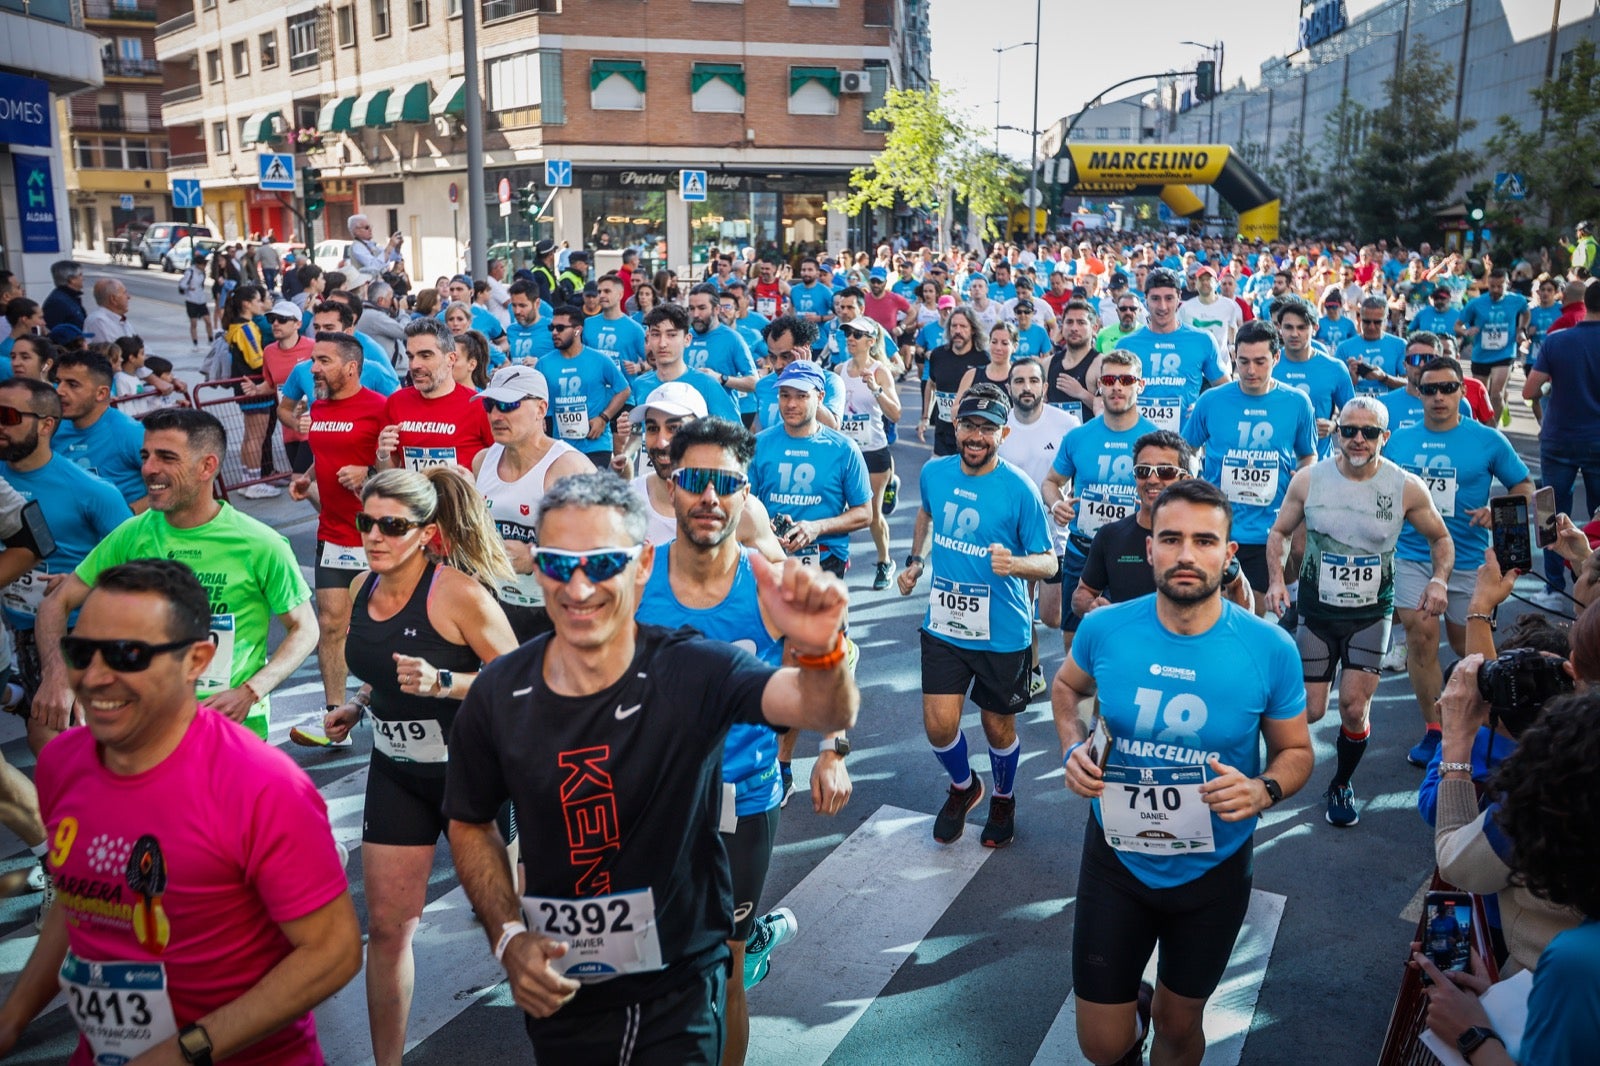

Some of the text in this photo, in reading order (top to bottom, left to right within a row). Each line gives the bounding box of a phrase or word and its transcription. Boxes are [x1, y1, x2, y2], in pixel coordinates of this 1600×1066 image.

[1088, 151, 1209, 170] MARCELINO
[1150, 353, 1181, 376] 18
[558, 375, 581, 396] 18
[558, 413, 582, 423] 1500
[1141, 407, 1174, 419] 2043
[310, 421, 354, 433] MARCELINO
[400, 420, 456, 435] MARCELINO
[841, 421, 864, 431] 2421
[1237, 421, 1274, 449] 18
[1227, 449, 1280, 460] MARCELINO
[778, 462, 816, 494] 18
[1097, 455, 1134, 484] 18
[1231, 467, 1271, 482] 1305
[769, 492, 822, 505] MARCELINO
[1087, 502, 1126, 519] 1408
[1375, 510, 1393, 521] OTSO
[942, 501, 980, 541] 18
[934, 533, 988, 558] MARCELINO
[1329, 565, 1373, 581] 1218
[938, 591, 979, 613] 1055
[1134, 687, 1208, 743] 18
[1116, 737, 1220, 765] MARCELINO
[1123, 785, 1181, 811] 710
[1140, 811, 1169, 821] DANIEL
[50, 816, 79, 867] 9
[540, 898, 633, 936] 2392
[571, 936, 604, 949] JAVIER
[70, 985, 153, 1026] 2413
